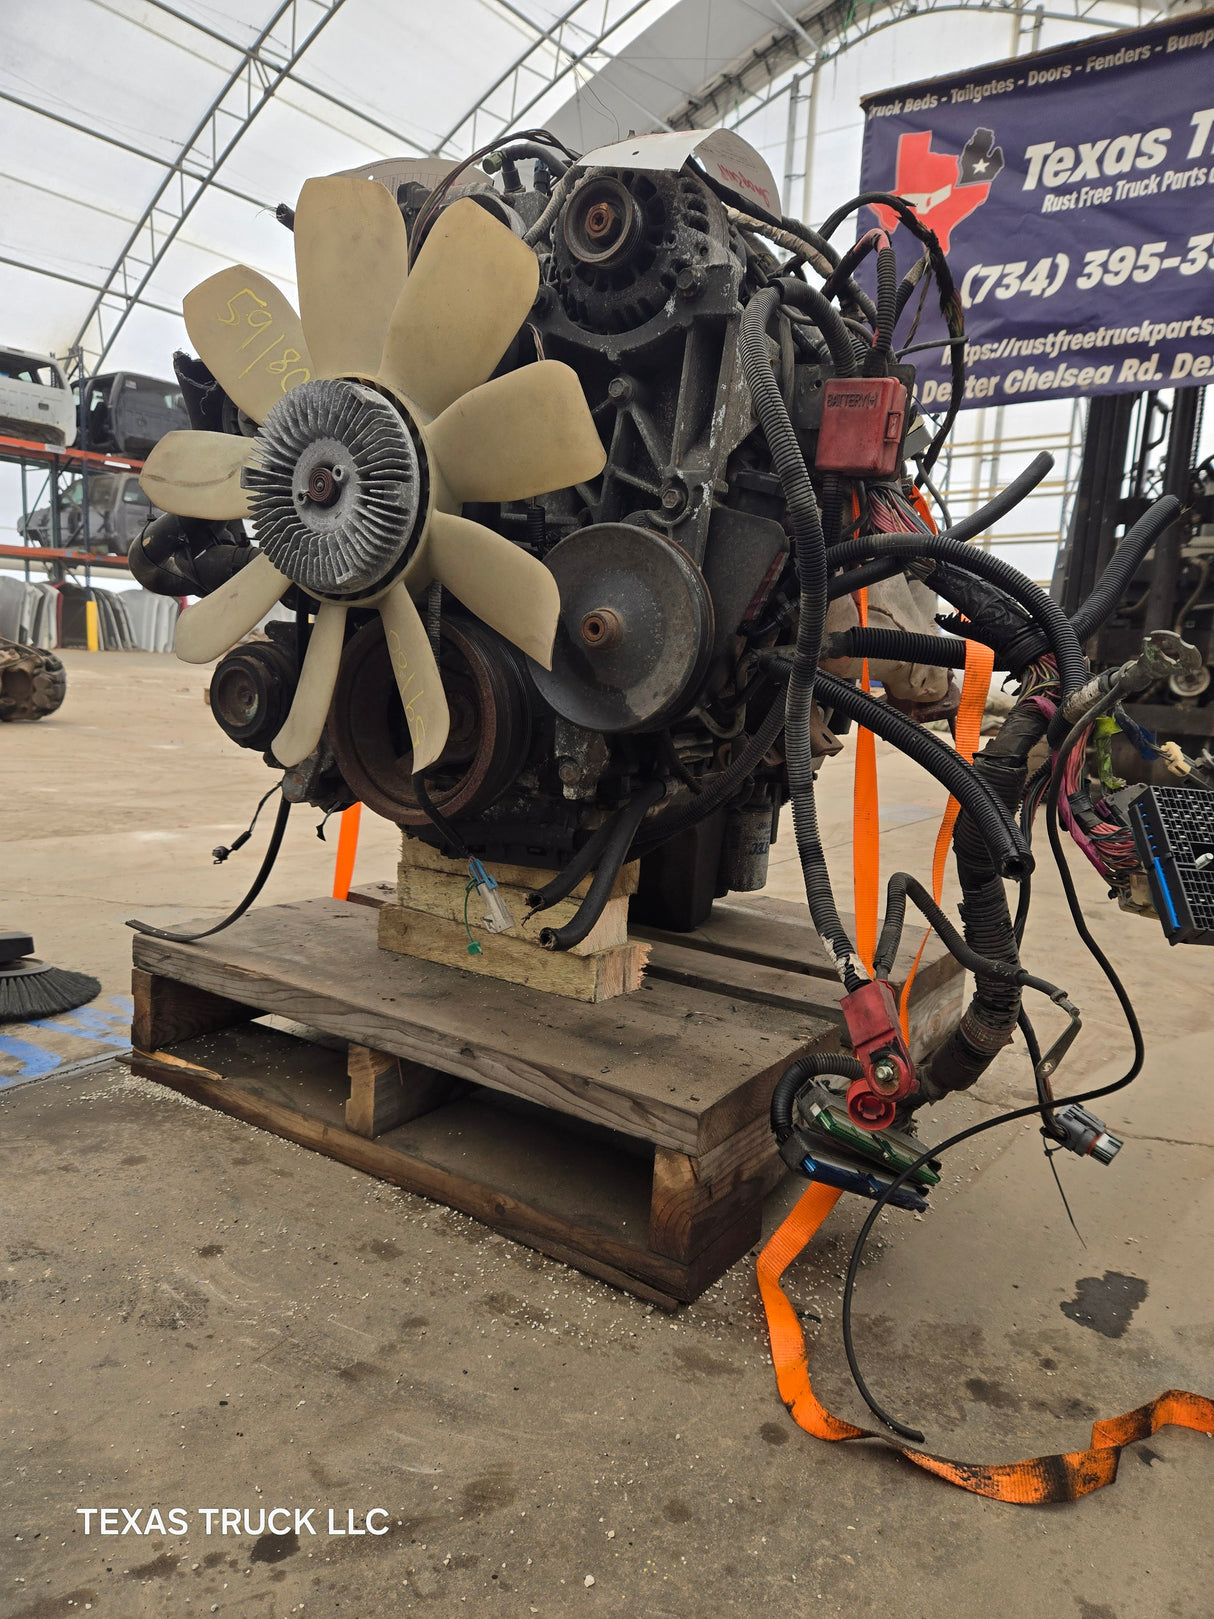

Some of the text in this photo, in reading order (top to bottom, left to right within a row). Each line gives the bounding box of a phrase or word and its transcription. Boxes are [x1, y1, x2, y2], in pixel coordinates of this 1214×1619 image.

[903, 93, 938, 113] Beds
[951, 78, 1014, 104] Tailgates
[1028, 65, 1071, 87] Doors
[1086, 44, 1151, 72] Fenders
[1022, 107, 1214, 192] Texas T
[1041, 190, 1077, 213] Rust
[1078, 185, 1111, 209] Free
[1115, 173, 1161, 200] Truck
[1160, 166, 1208, 192] Parts
[960, 232, 1214, 309] (734) 395-3
[921, 374, 1001, 404] Deter
[1003, 363, 1112, 394] Chelsea
[1117, 353, 1163, 383] Rd.
